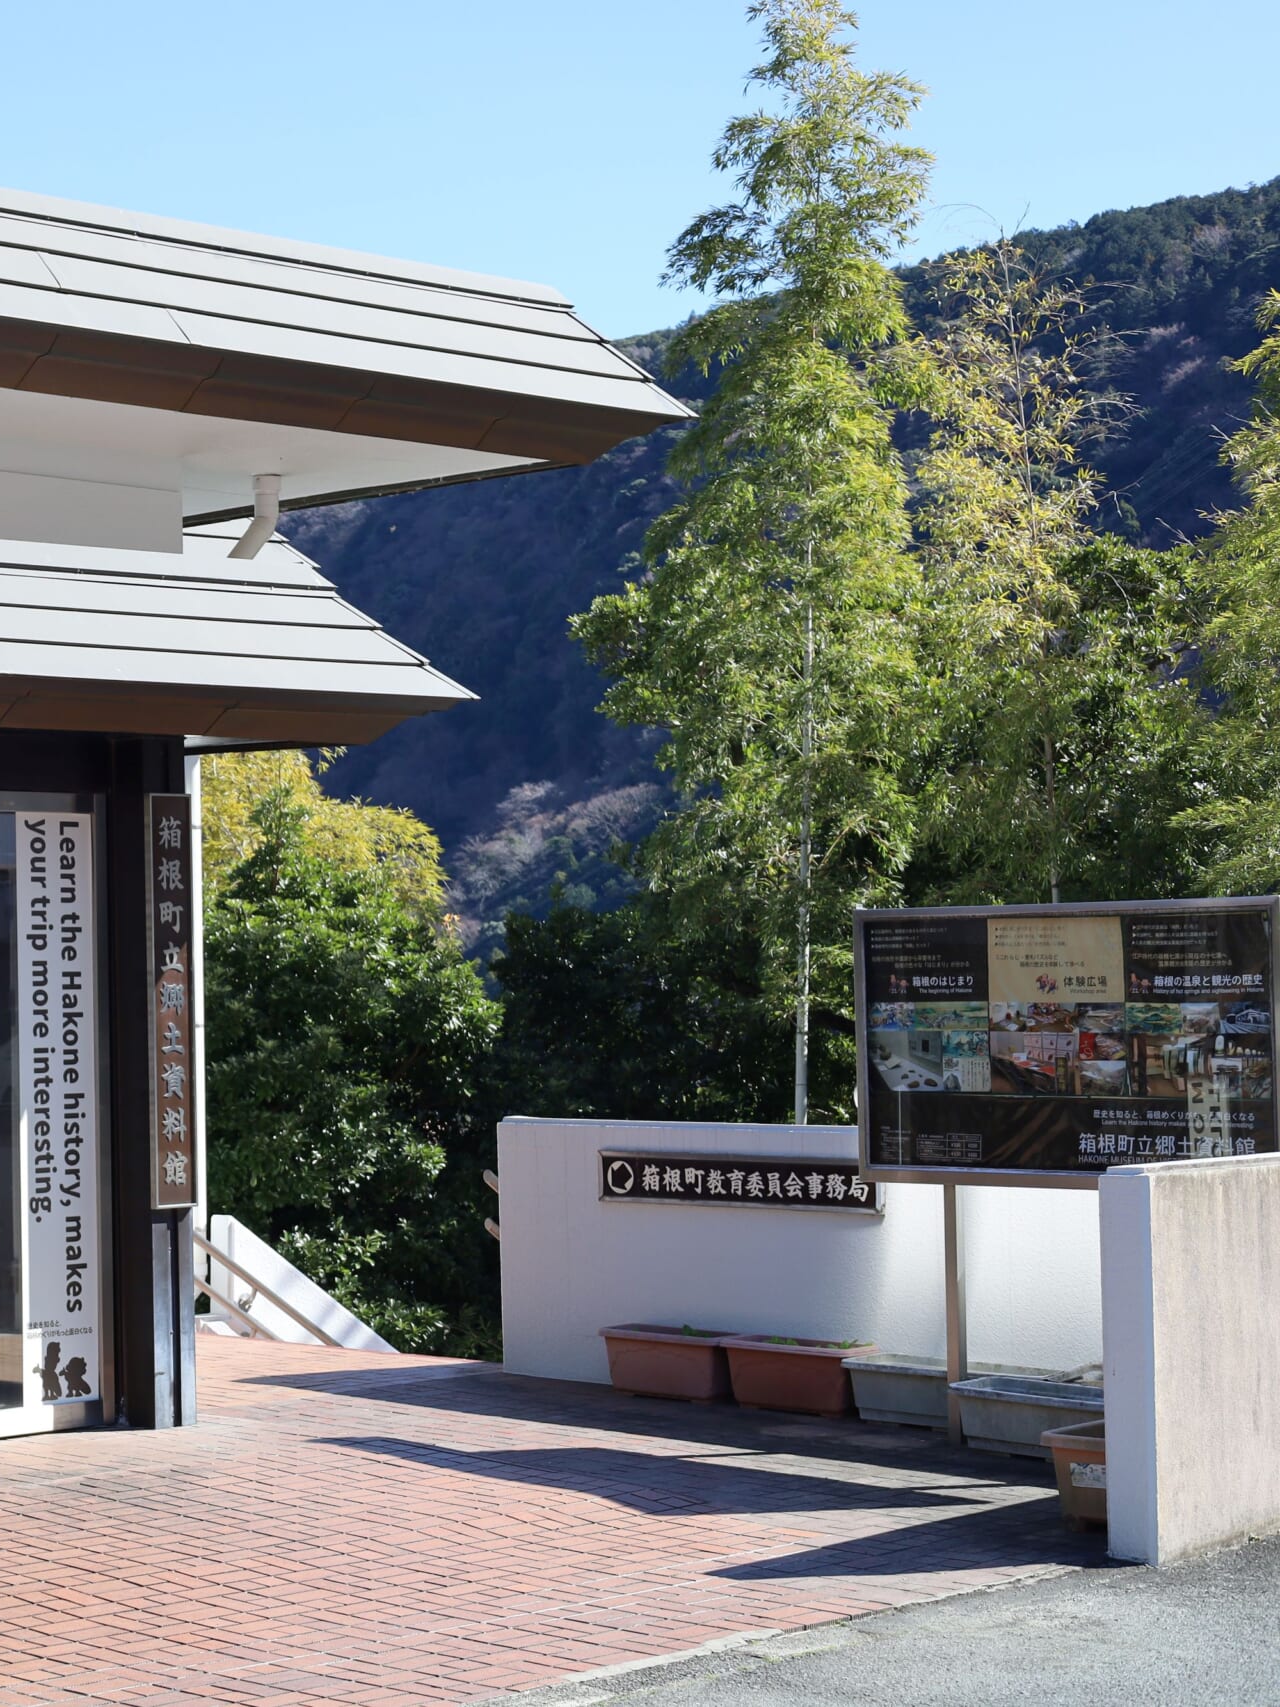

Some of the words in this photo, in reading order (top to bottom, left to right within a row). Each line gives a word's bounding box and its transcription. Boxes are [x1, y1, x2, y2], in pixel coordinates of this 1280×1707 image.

[24, 818, 47, 890] your
[58, 820, 80, 904] Learn
[25, 895, 54, 952] trip
[61, 911, 82, 963] the
[31, 960, 50, 1039] more
[912, 975, 974, 987] 箱根のはじまり
[1063, 975, 1108, 988] 体験広場
[1153, 974, 1264, 987] 箱根の温泉と観光の歴史
[61, 970, 85, 1085] Hakone
[29, 1046, 58, 1224] interesting.
[59, 1087, 86, 1207] history,
[1078, 1154, 1109, 1165] HAKONE
[1079, 1132, 1256, 1158] 箱根町立郷土資料館
[641, 1164, 869, 1202] 箱根町教育委員会事務局
[64, 1214, 88, 1313] makes
